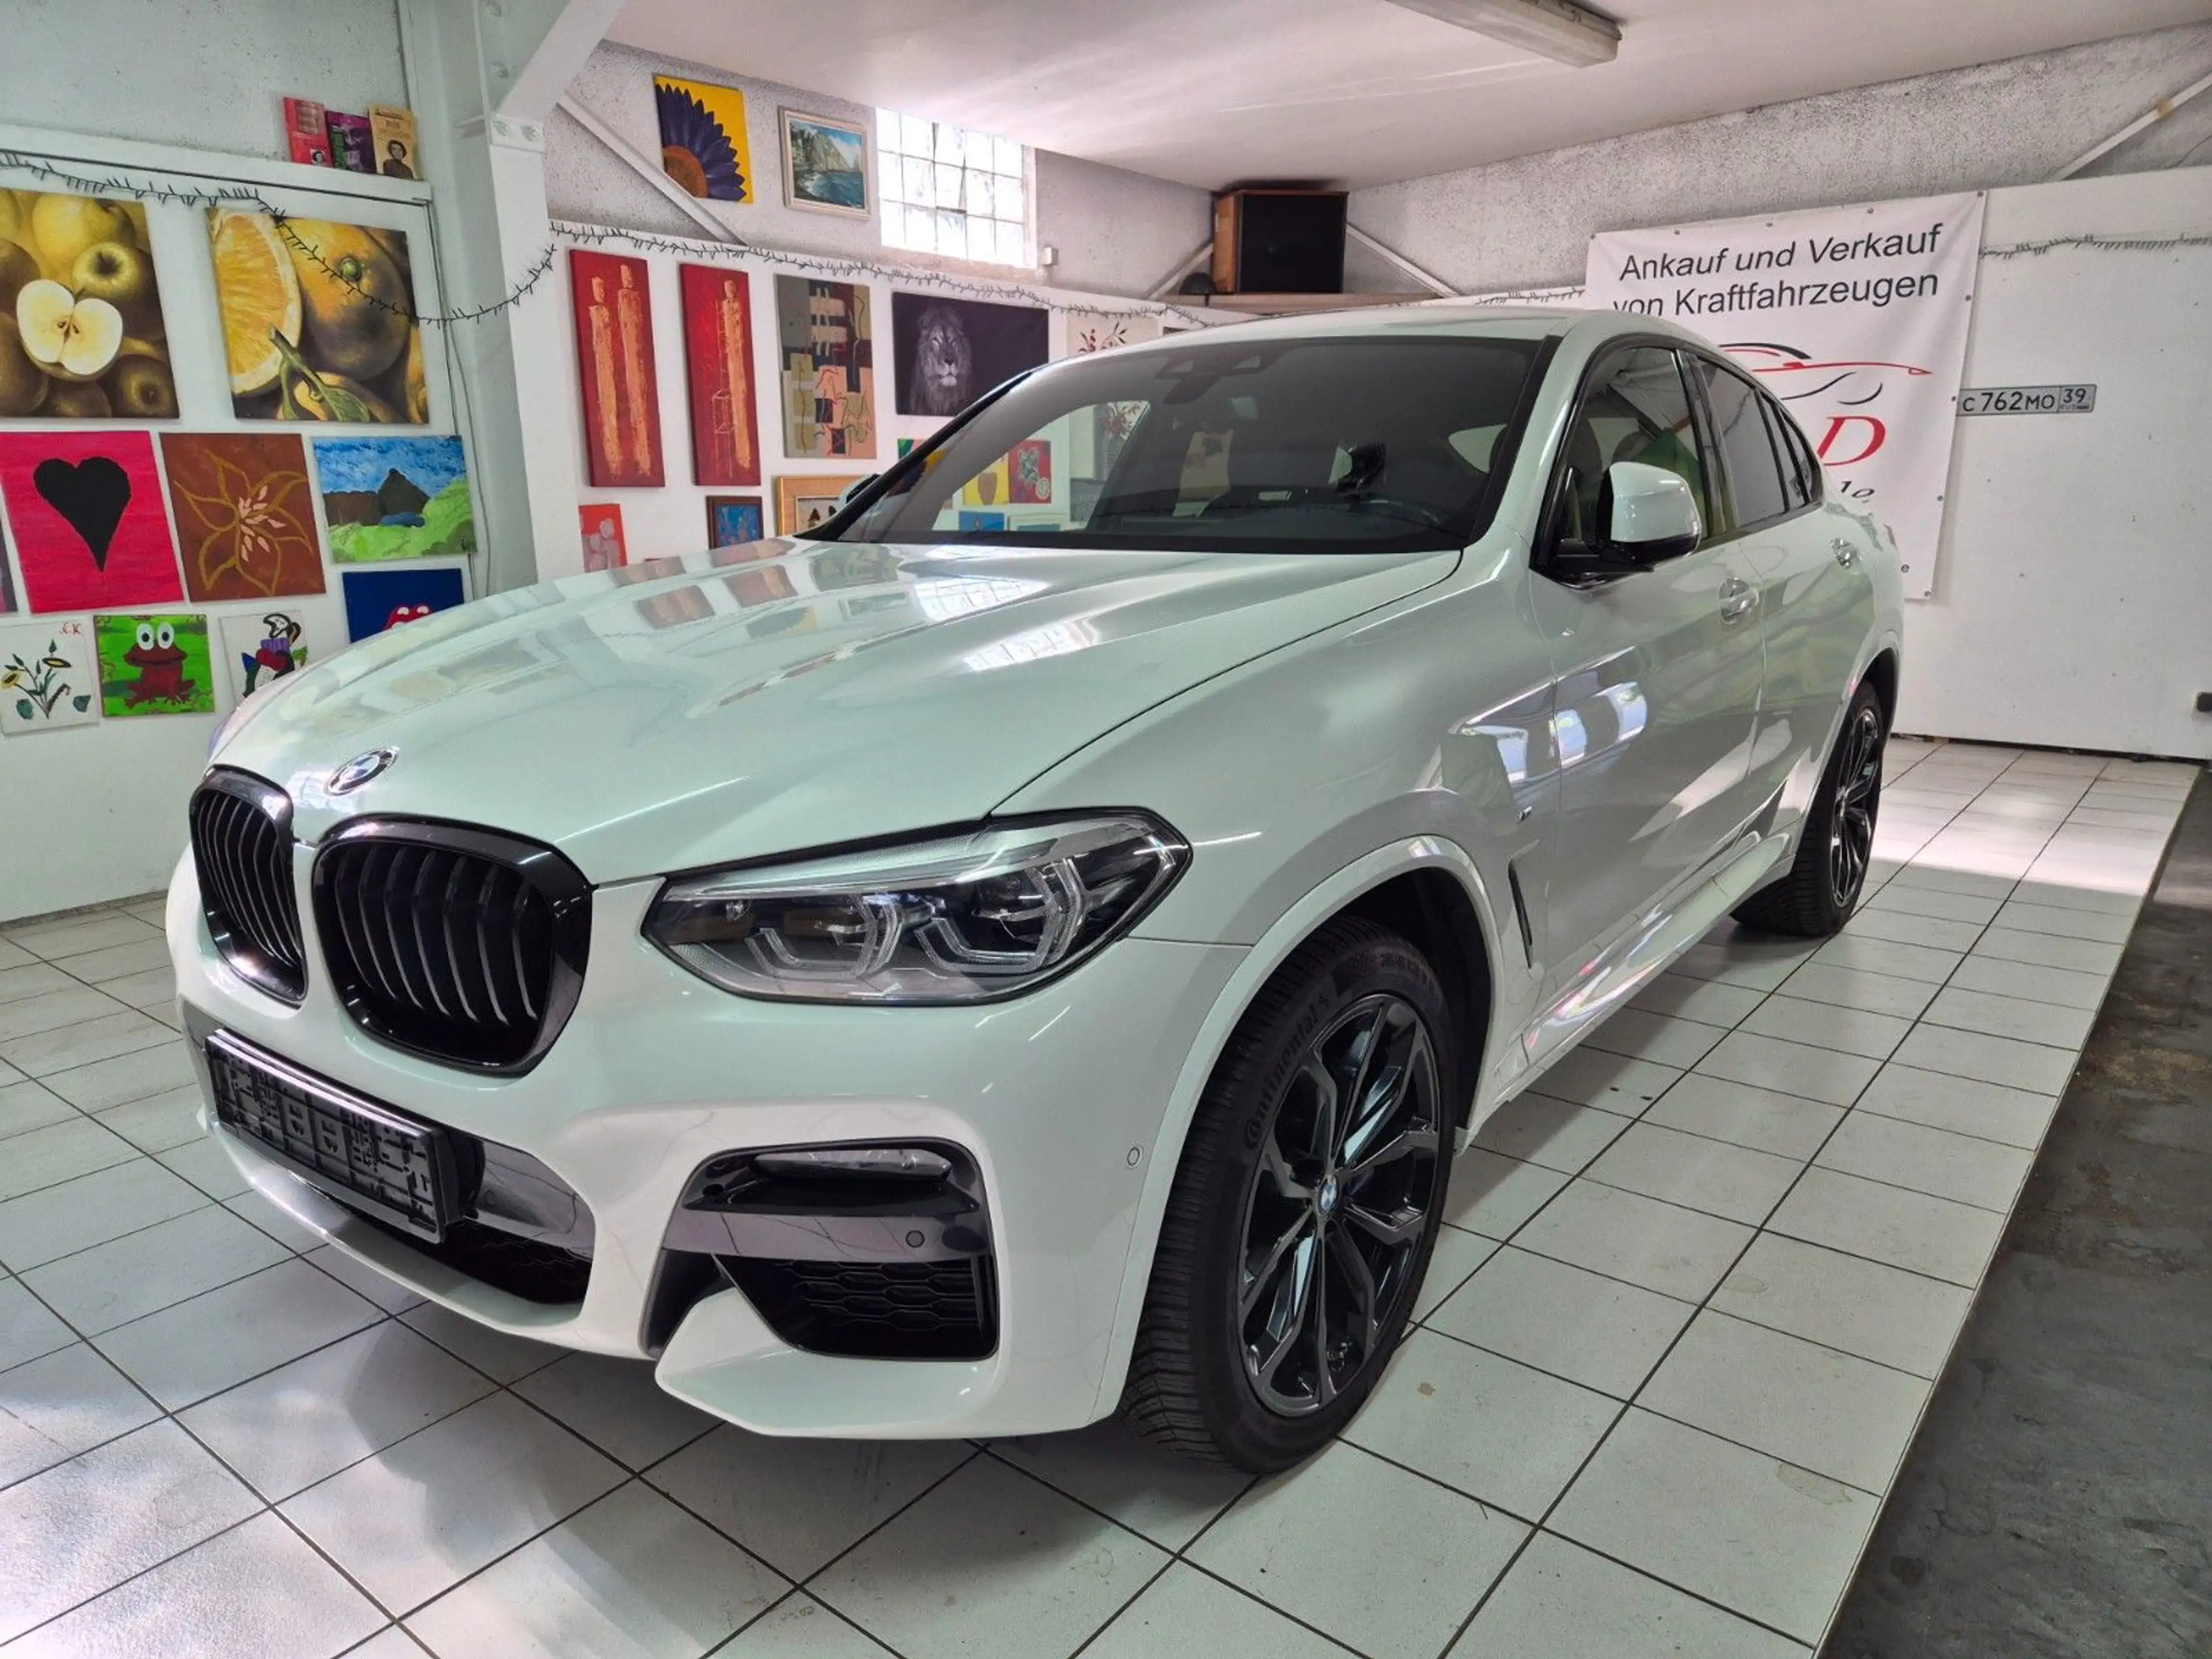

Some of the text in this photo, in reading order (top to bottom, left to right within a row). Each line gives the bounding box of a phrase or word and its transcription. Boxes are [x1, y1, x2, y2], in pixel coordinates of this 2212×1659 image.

[1619, 222, 1943, 281] Ankauf und Verkauf
[1675, 272, 1938, 316] Kraftfahrzeugen
[2063, 388, 2086, 403] 39
